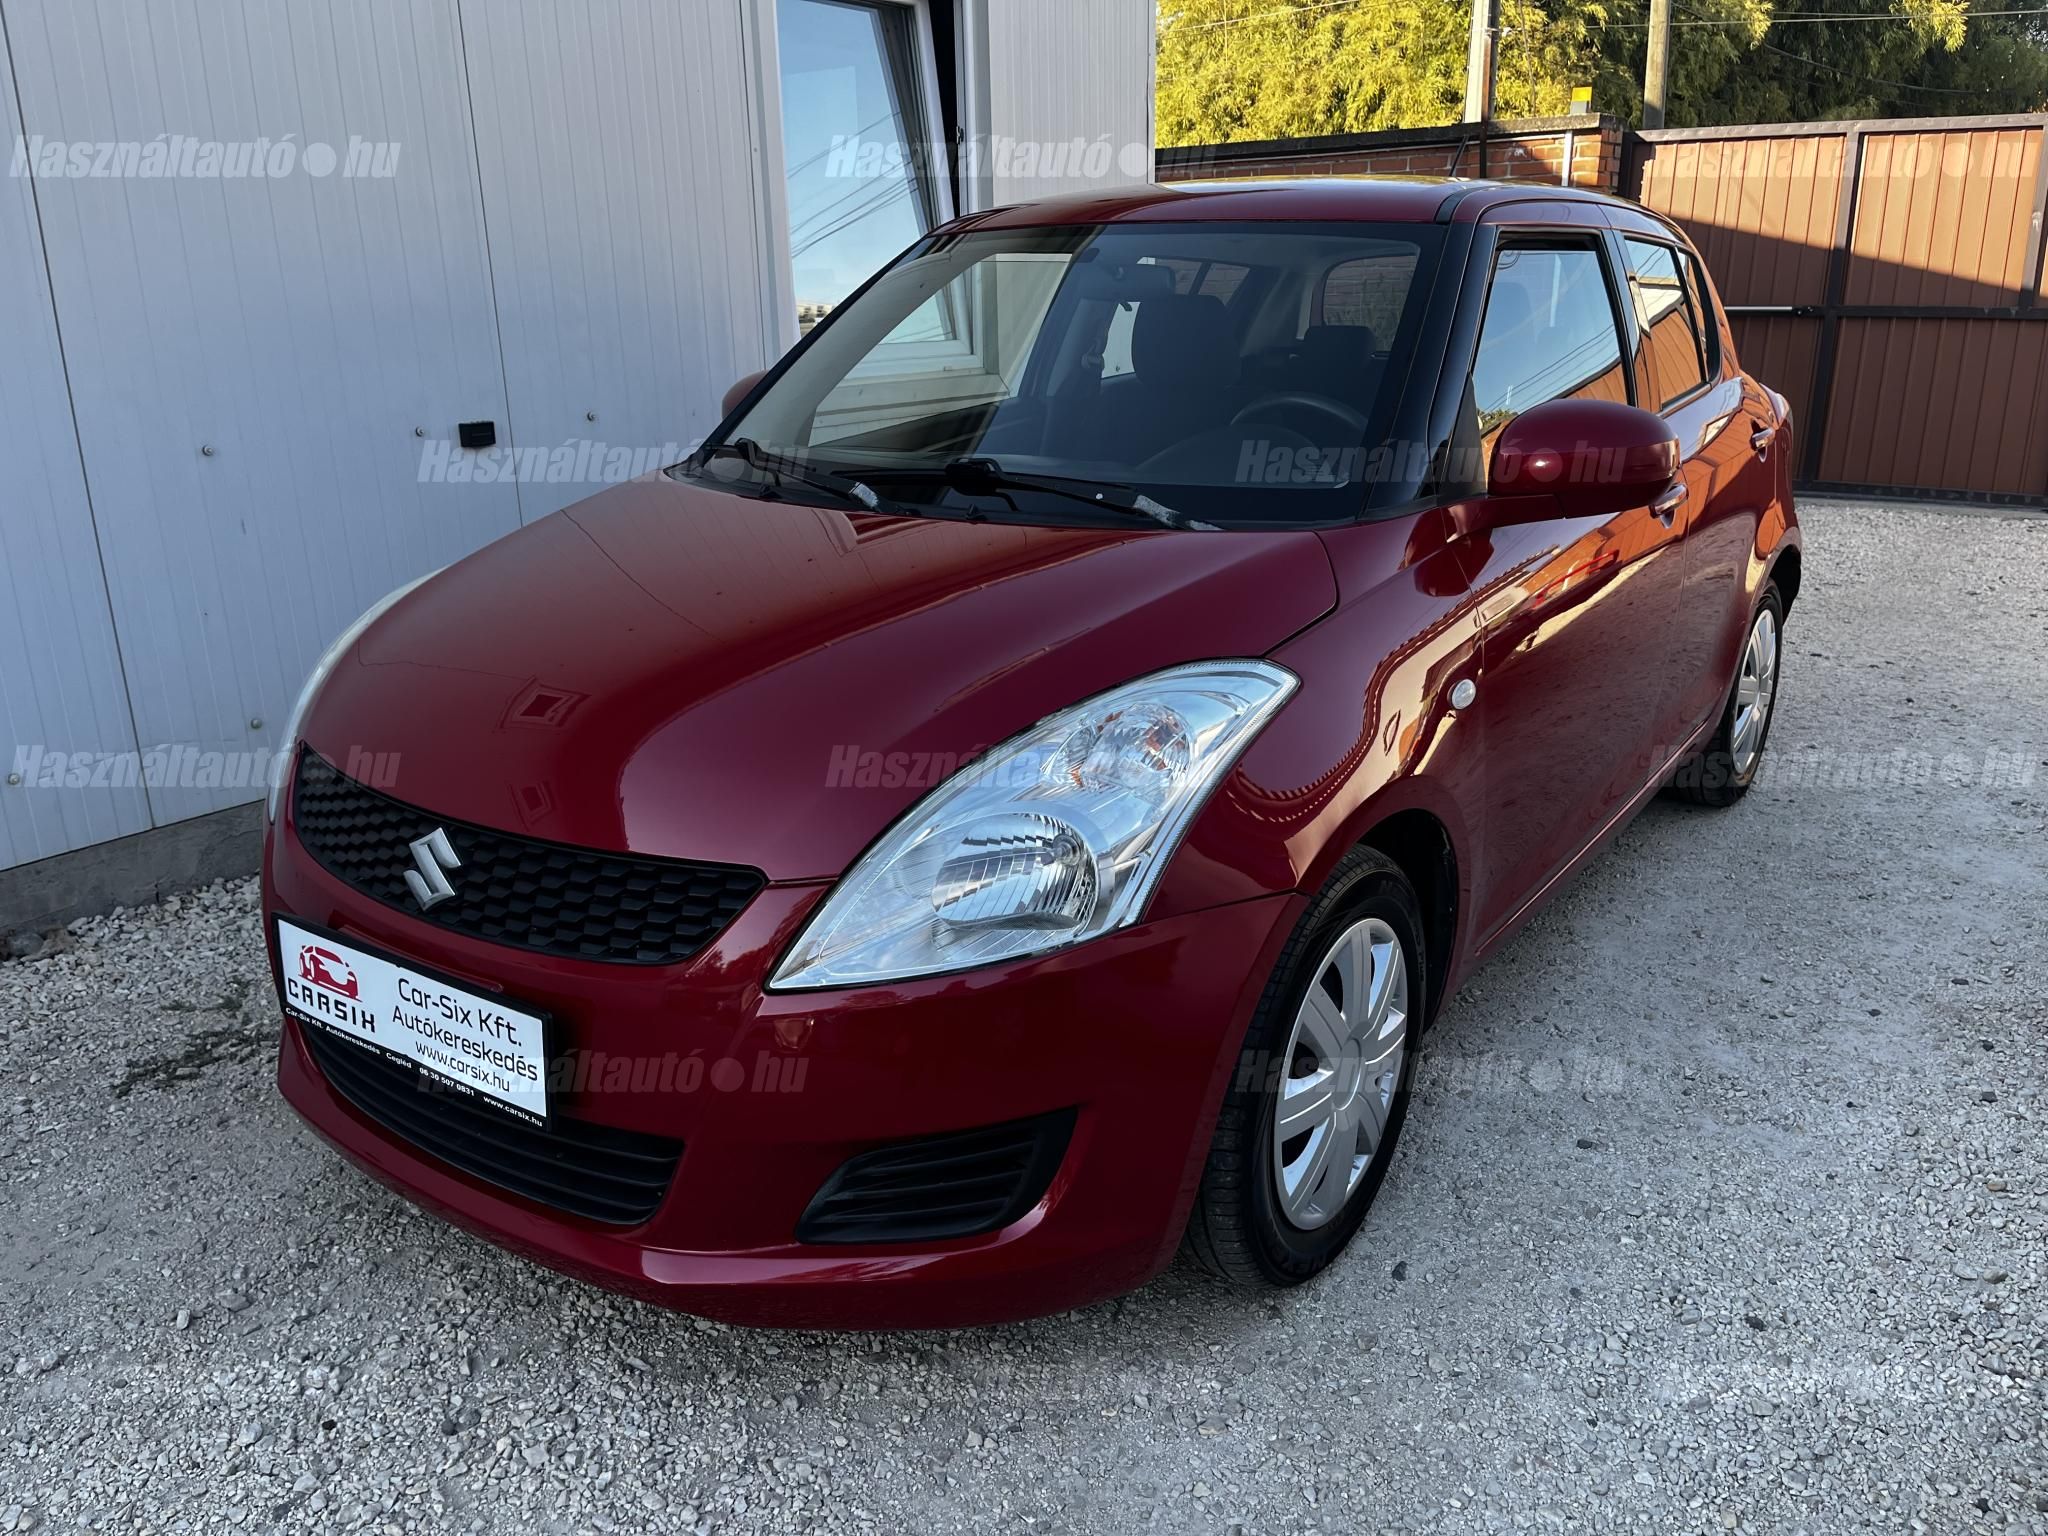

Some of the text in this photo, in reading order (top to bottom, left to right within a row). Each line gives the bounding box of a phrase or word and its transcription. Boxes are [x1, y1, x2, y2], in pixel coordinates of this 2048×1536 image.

[393, 1006, 538, 1081] Autókereskedés
[398, 978, 522, 1047] Car-Six Kft.
[285, 1007, 310, 1026] Car-Six
[311, 1016, 324, 1030] Kft.
[325, 1025, 381, 1055] Autókereskedés
[386, 1051, 412, 1069] Cegléd
[440, 1074, 455, 1089] 507
[483, 1095, 543, 1128] www.carsix.hu
[416, 1040, 510, 1093] www.carsix.hu
